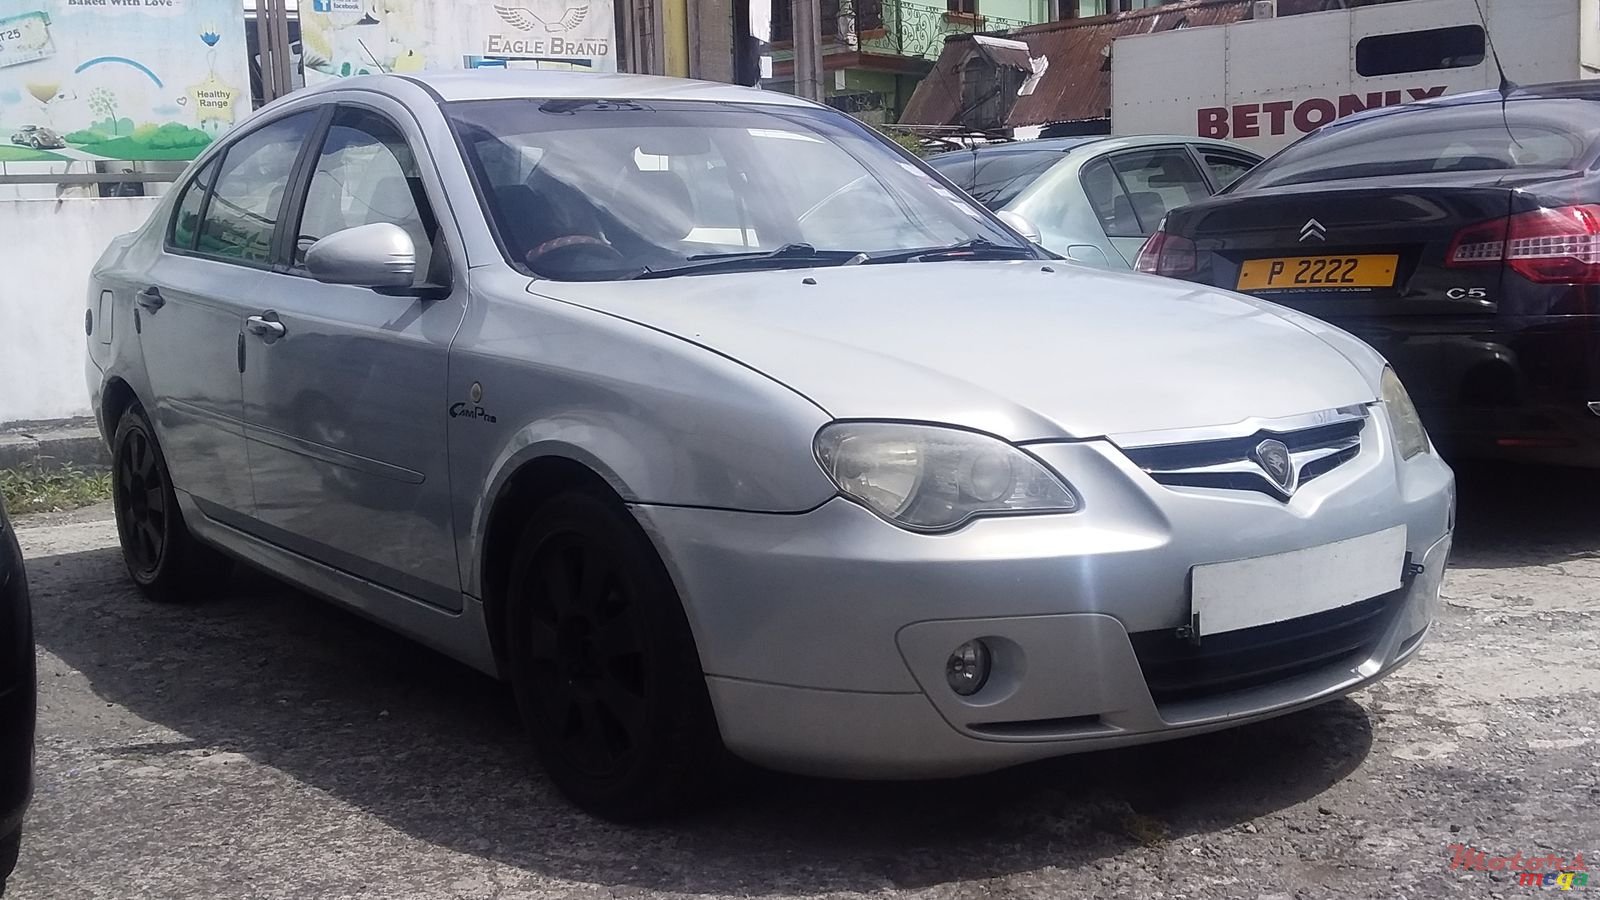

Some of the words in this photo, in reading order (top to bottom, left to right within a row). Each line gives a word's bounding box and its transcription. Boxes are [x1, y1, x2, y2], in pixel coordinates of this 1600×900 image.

[333, 2, 359, 10] facebook
[487, 34, 544, 54] EAGLE
[550, 37, 608, 56] BRAND
[196, 89, 231, 100] Healthy
[199, 99, 228, 109] Range
[1267, 260, 1285, 285] P
[1293, 258, 1358, 285] 2222
[1446, 287, 1487, 300] C5
